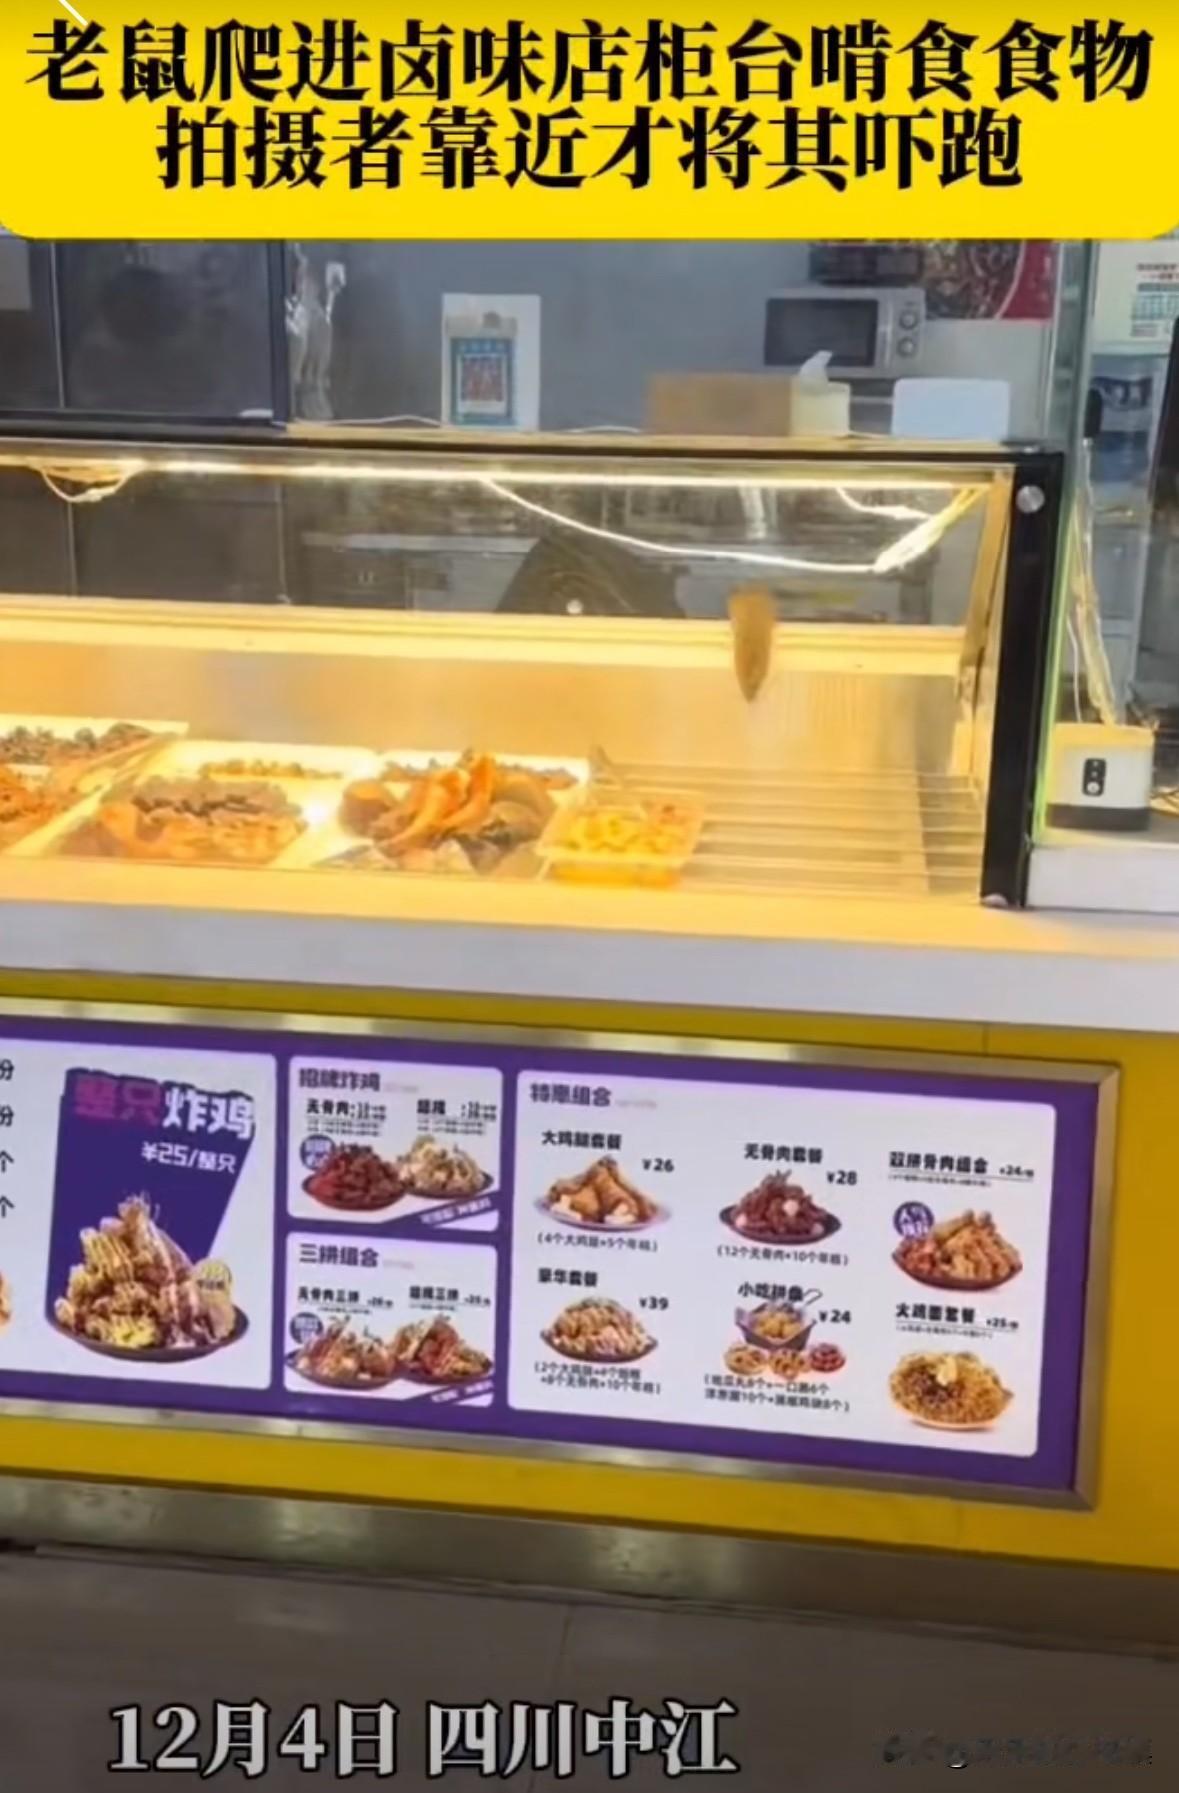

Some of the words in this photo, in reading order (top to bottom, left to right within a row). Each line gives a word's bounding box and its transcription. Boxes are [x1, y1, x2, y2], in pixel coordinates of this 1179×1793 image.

[76, 1074, 255, 1140] 整只炸鸡
[541, 1130, 622, 1151] 大鸡腿套餐
[299, 1243, 379, 1268] 三拼组合
